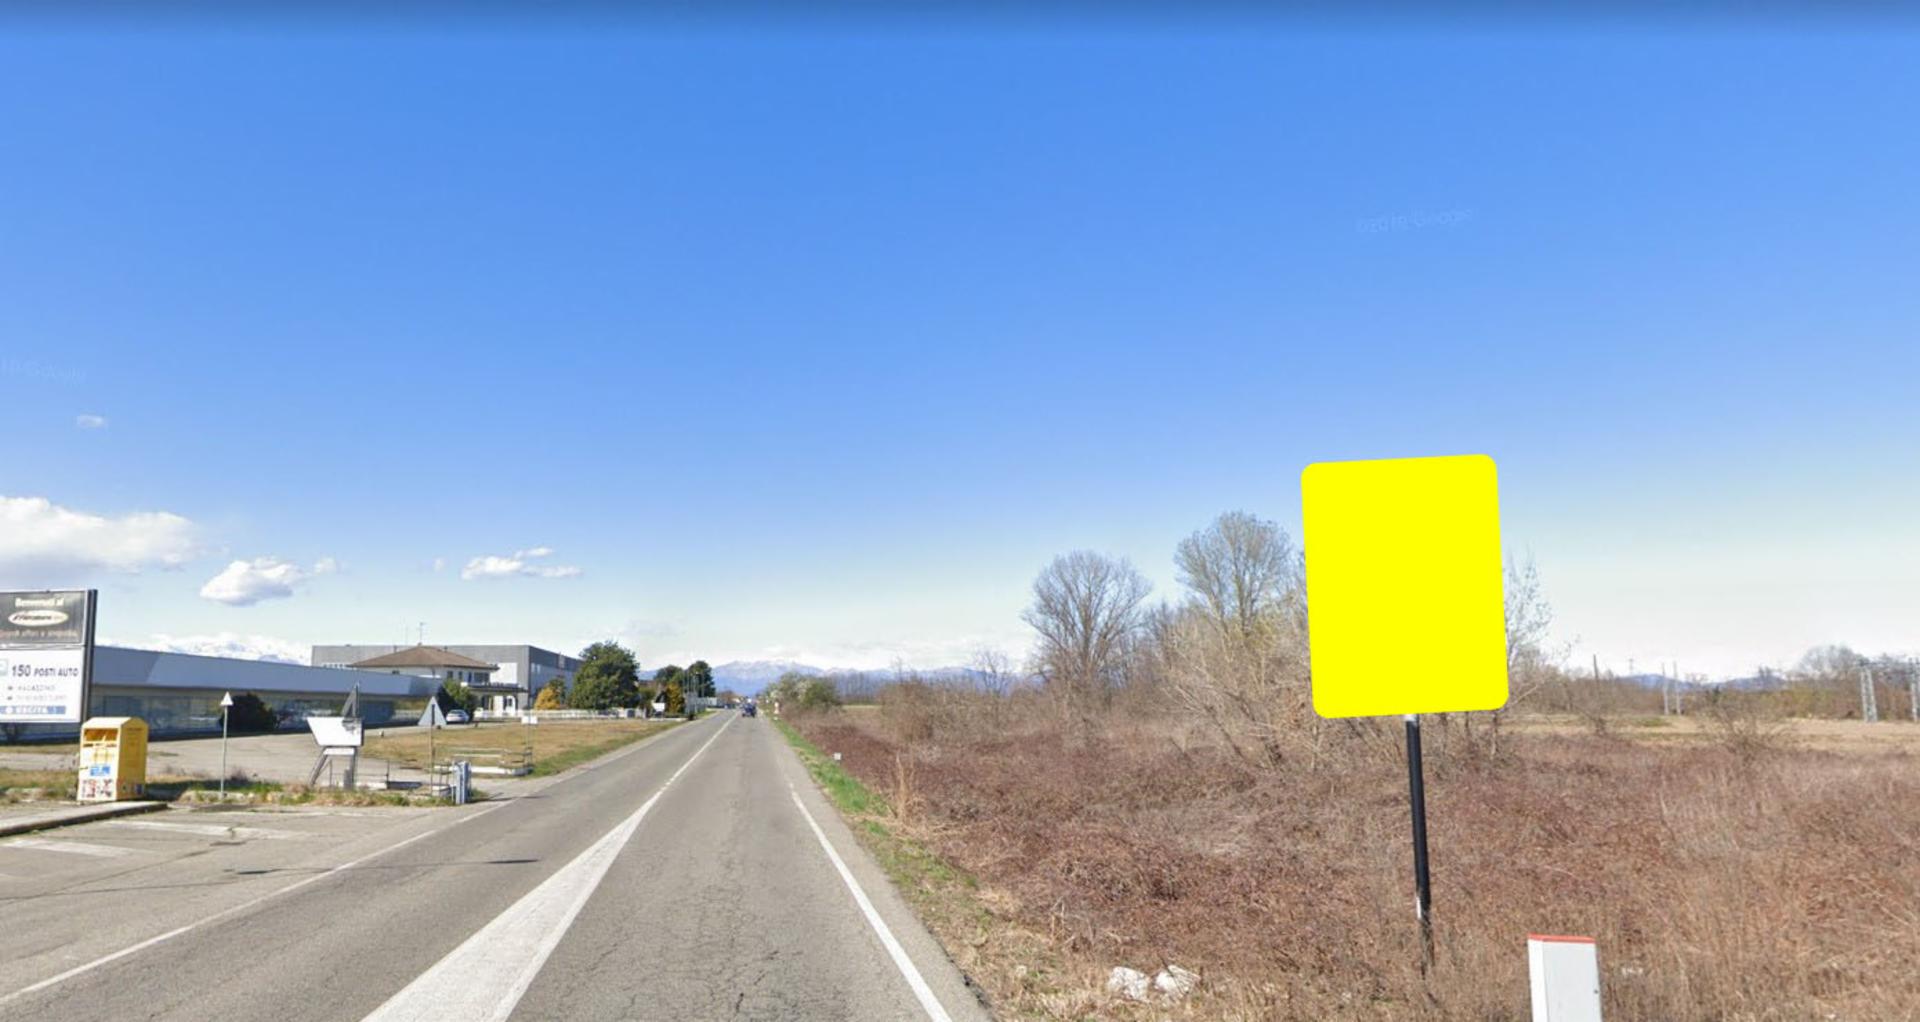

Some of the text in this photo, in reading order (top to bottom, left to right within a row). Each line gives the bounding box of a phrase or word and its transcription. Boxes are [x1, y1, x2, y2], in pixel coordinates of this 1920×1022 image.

[12, 664, 79, 677] 150 POSTI AUTO
